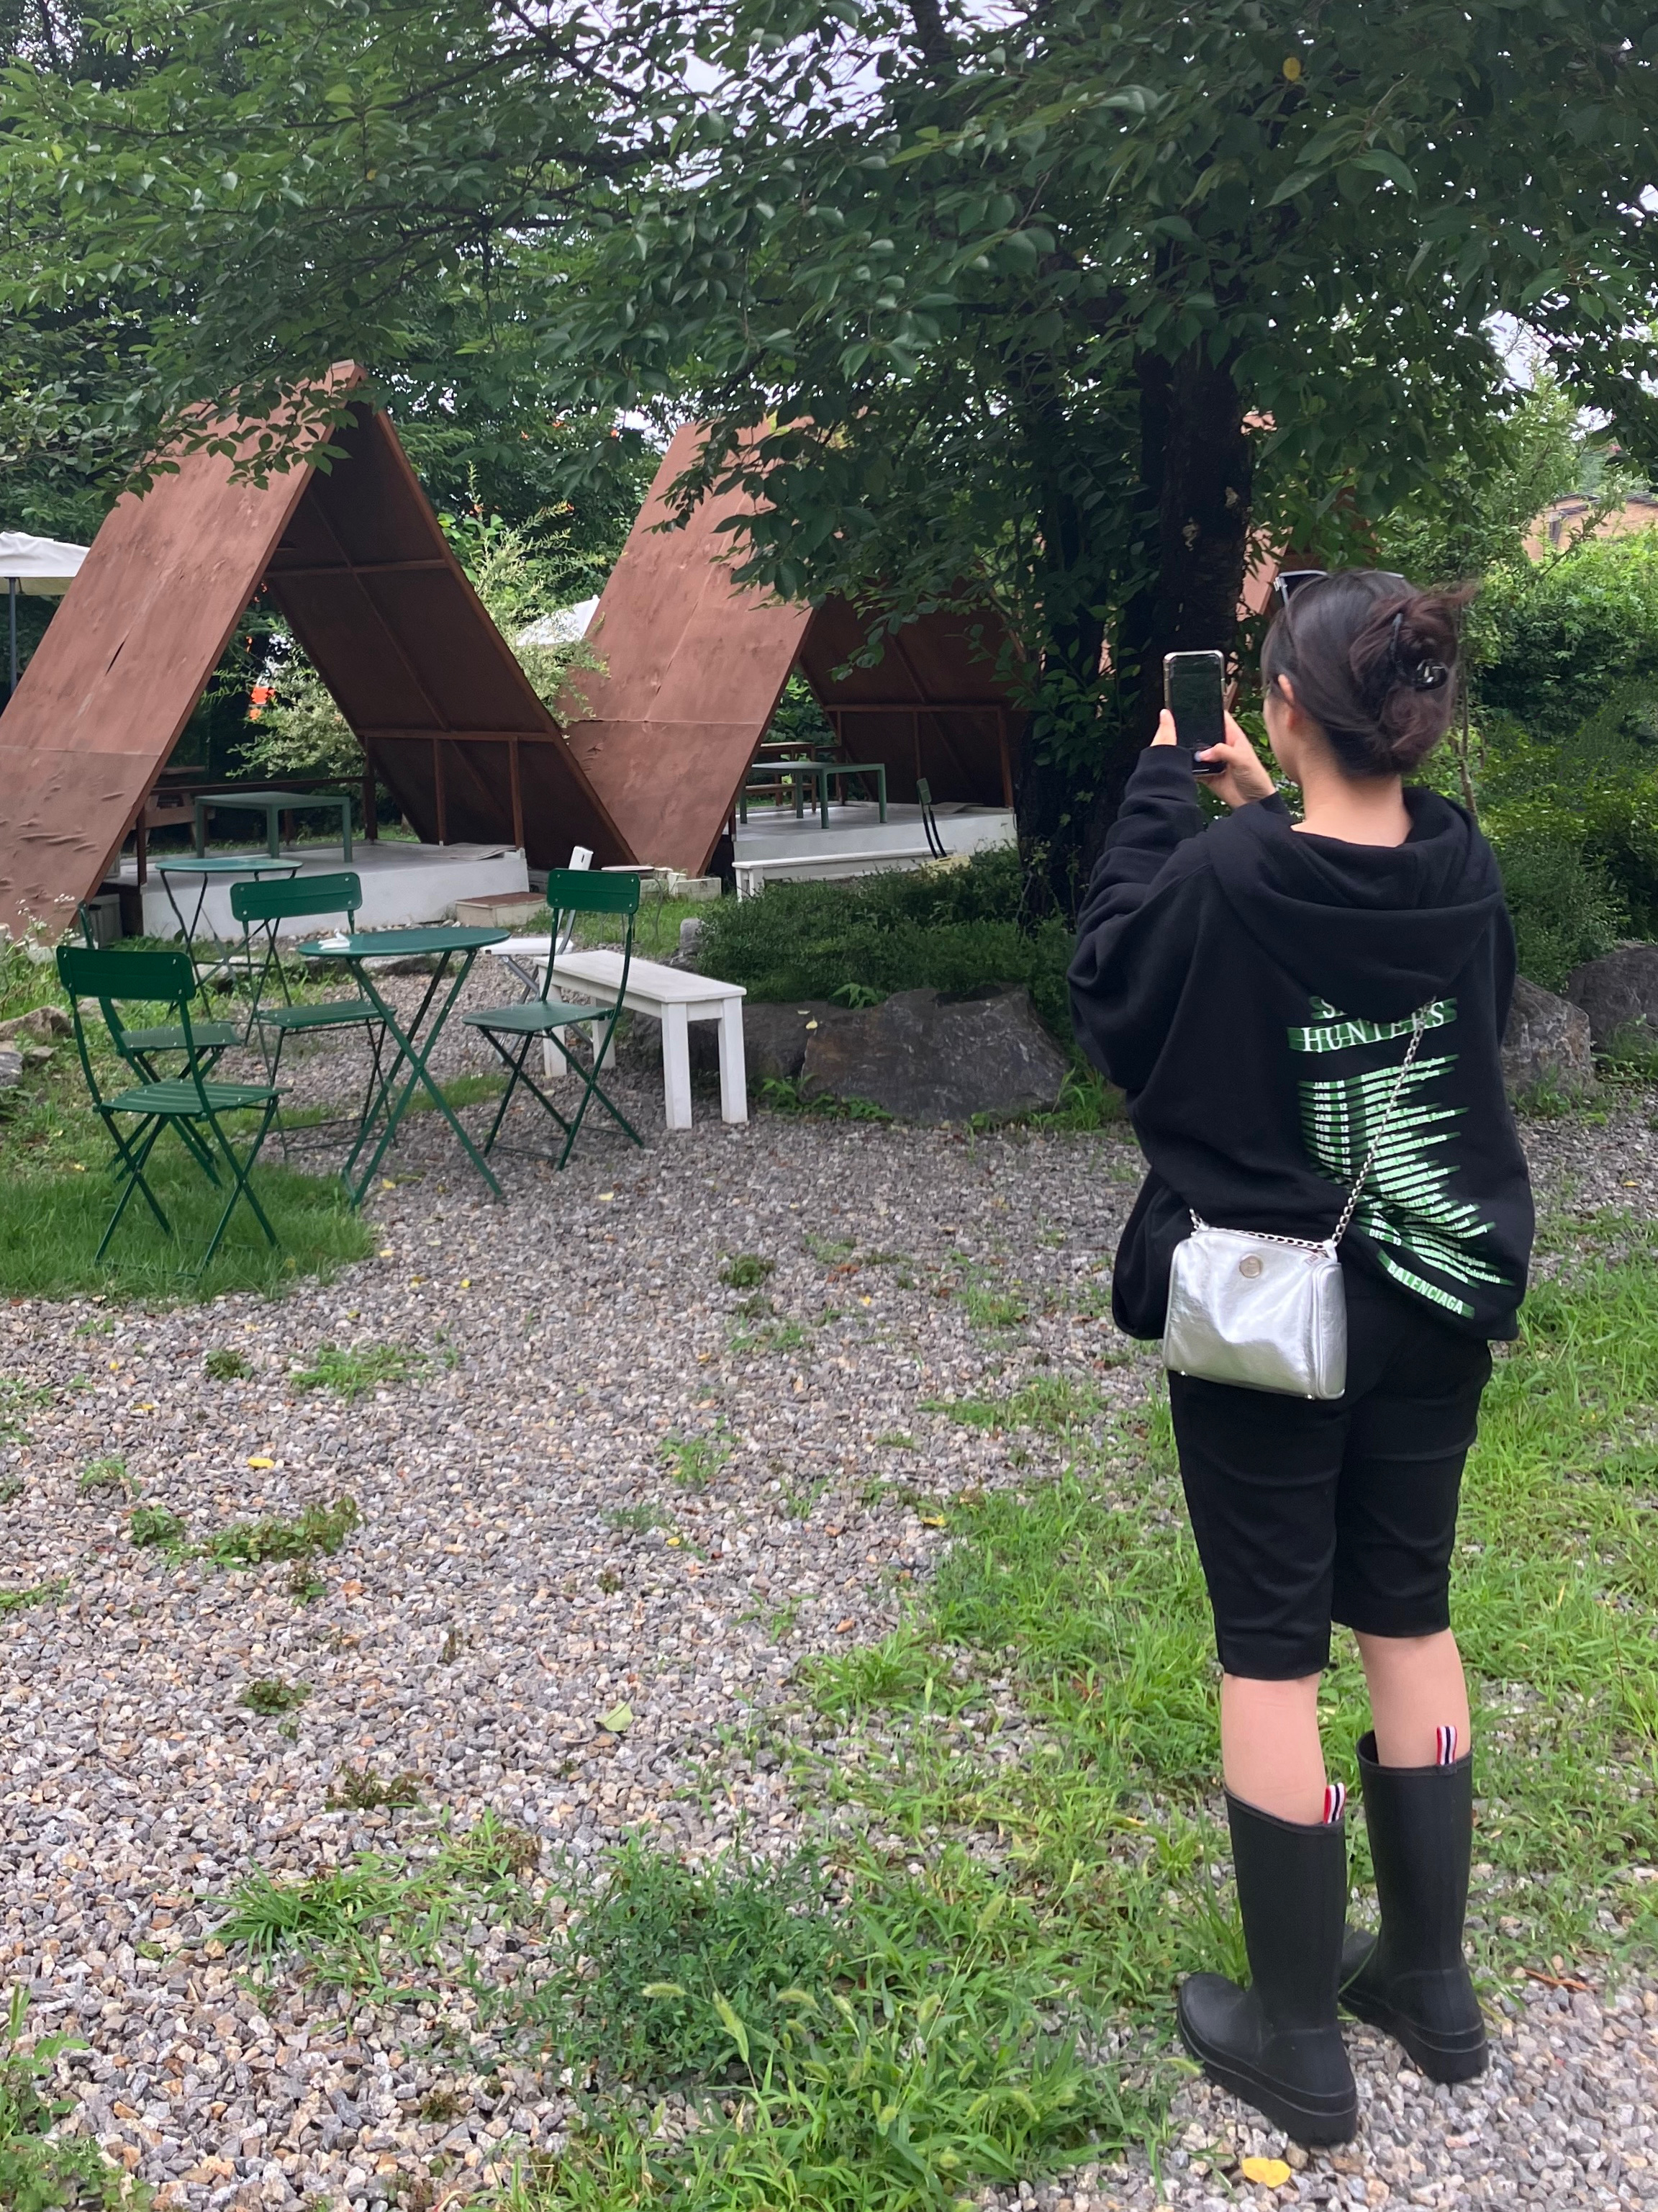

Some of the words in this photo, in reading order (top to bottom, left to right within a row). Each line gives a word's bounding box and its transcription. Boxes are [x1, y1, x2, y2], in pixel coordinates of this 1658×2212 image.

[1315, 1123, 1331, 1132] FEB
[1371, 1218, 1387, 1229] DEC
[1369, 1229, 1386, 1240] DEC
[1458, 1224, 1487, 1239] Germany
[1457, 1252, 1486, 1268] Belgium
[1464, 1267, 1500, 1284] Caledonia
[1387, 1259, 1463, 1315] BALENCIAGA
